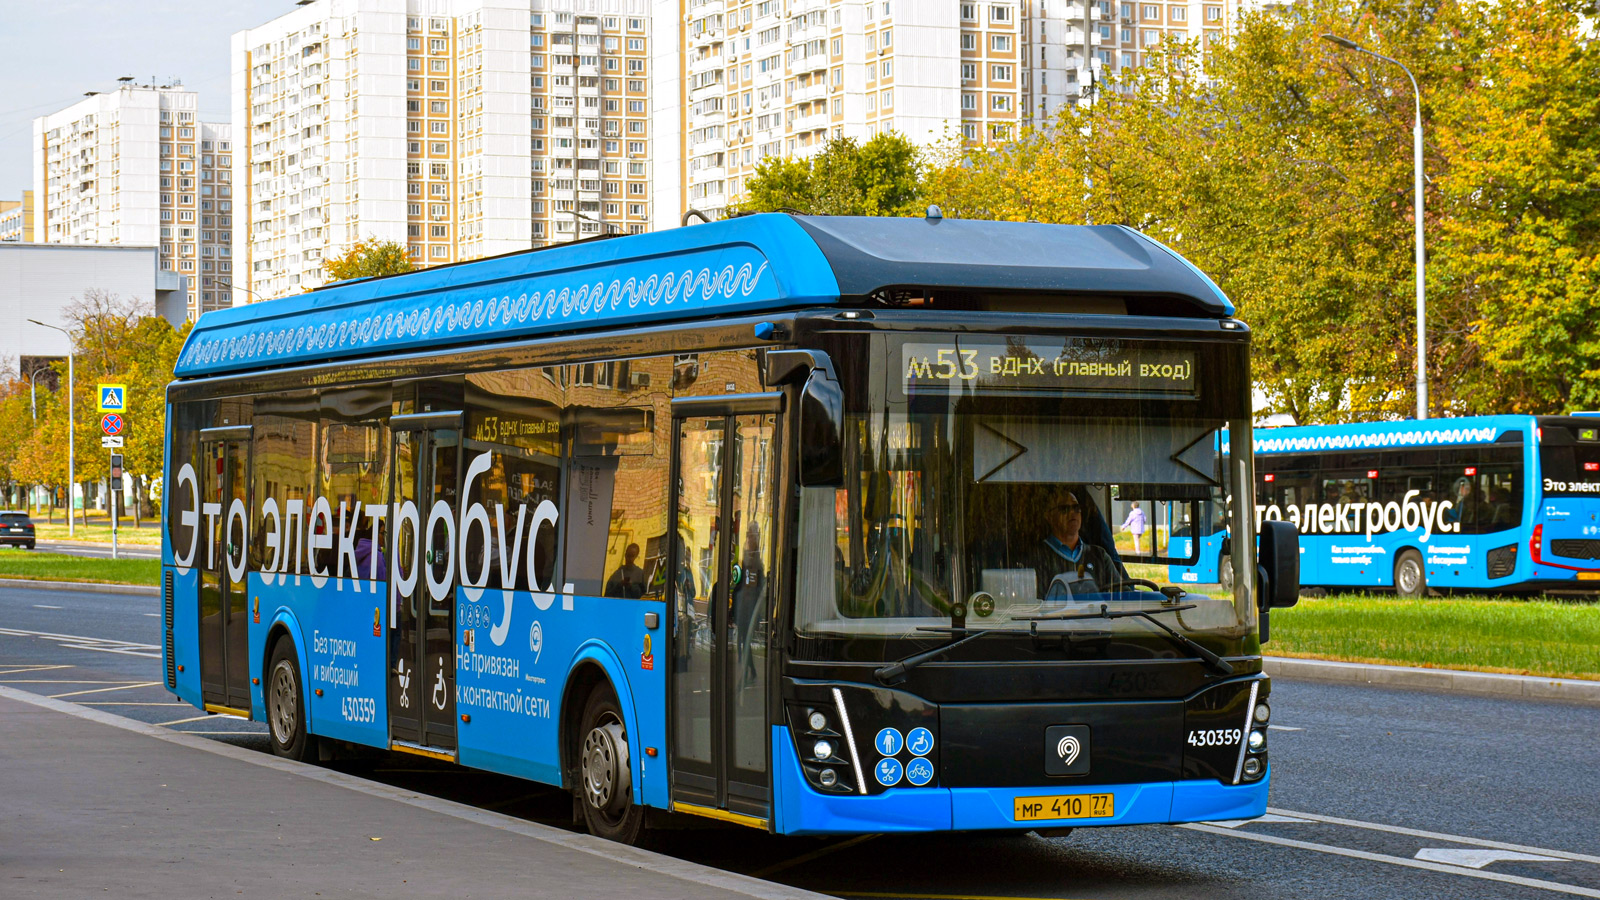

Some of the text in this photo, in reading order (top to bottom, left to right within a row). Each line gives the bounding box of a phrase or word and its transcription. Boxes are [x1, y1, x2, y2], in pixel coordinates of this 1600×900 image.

[906, 349, 1191, 380] м53 ВДНХ (главный вход)
[476, 417, 498, 442] м53
[500, 421, 518, 437] ВДНХ
[1543, 478, 1566, 491] Это
[1286, 489, 1461, 543] электробус.
[174, 449, 574, 646] Это электробус.
[314, 630, 356, 661] Без тряски
[313, 660, 359, 689] и вибраций
[456, 643, 520, 679] Не привязан
[341, 696, 376, 723] 430359
[456, 685, 550, 719] к контактной сети
[1187, 728, 1242, 747] 430359
[1051, 798, 1083, 817] 410
[1092, 796, 1109, 810] 77
